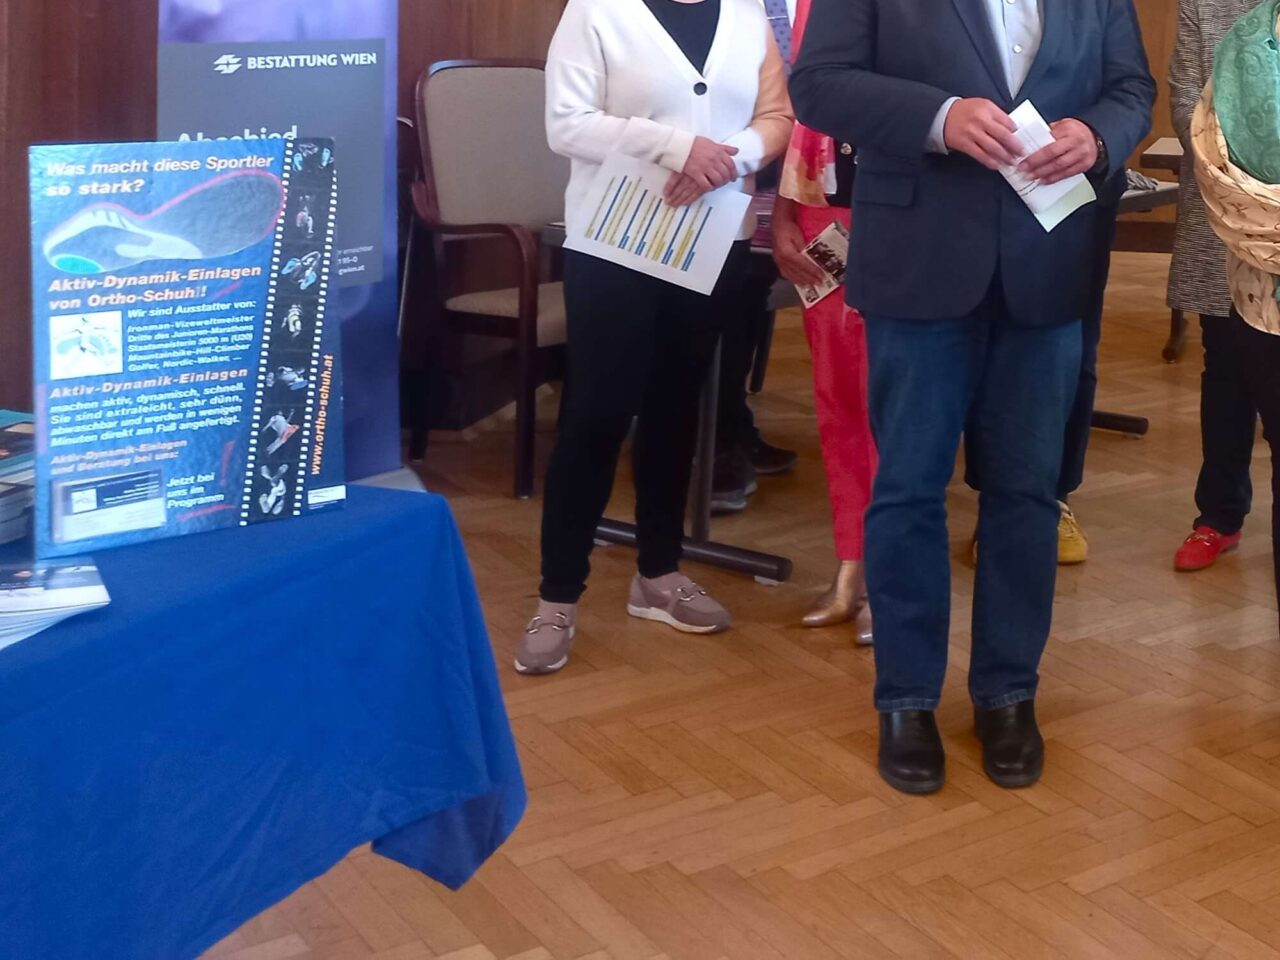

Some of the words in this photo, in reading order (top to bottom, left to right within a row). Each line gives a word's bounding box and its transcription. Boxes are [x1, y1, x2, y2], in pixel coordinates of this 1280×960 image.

[247, 54, 338, 70] BESTATTUNG
[340, 52, 377, 65] WIEN
[47, 161, 86, 176] Was
[90, 159, 150, 175] macht
[154, 158, 201, 172] diese
[206, 155, 275, 172] Sportler
[46, 184, 72, 197] so
[79, 178, 146, 196] stark?
[48, 266, 261, 292] Aktiv-Dynamik-Einlagen
[49, 298, 81, 311] von
[127, 309, 148, 319] Wir
[148, 306, 173, 317] sind
[174, 301, 233, 315] Ausstatter
[48, 368, 248, 399] Aktiv-Dynamik-Einlagen
[50, 401, 100, 413] machen
[50, 415, 72, 425] Sie
[75, 410, 103, 422] sind
[180, 398, 208, 409] sehr
[311, 354, 334, 475] www.ortho-schuh.at
[121, 416, 143, 427] und
[144, 412, 184, 424] werden
[186, 409, 197, 418] in
[50, 434, 98, 447] Minuten
[101, 428, 134, 440] direkt
[166, 475, 195, 488] Jetzt
[197, 471, 215, 483] bei
[167, 488, 188, 498] uns
[167, 493, 225, 509] Programm
